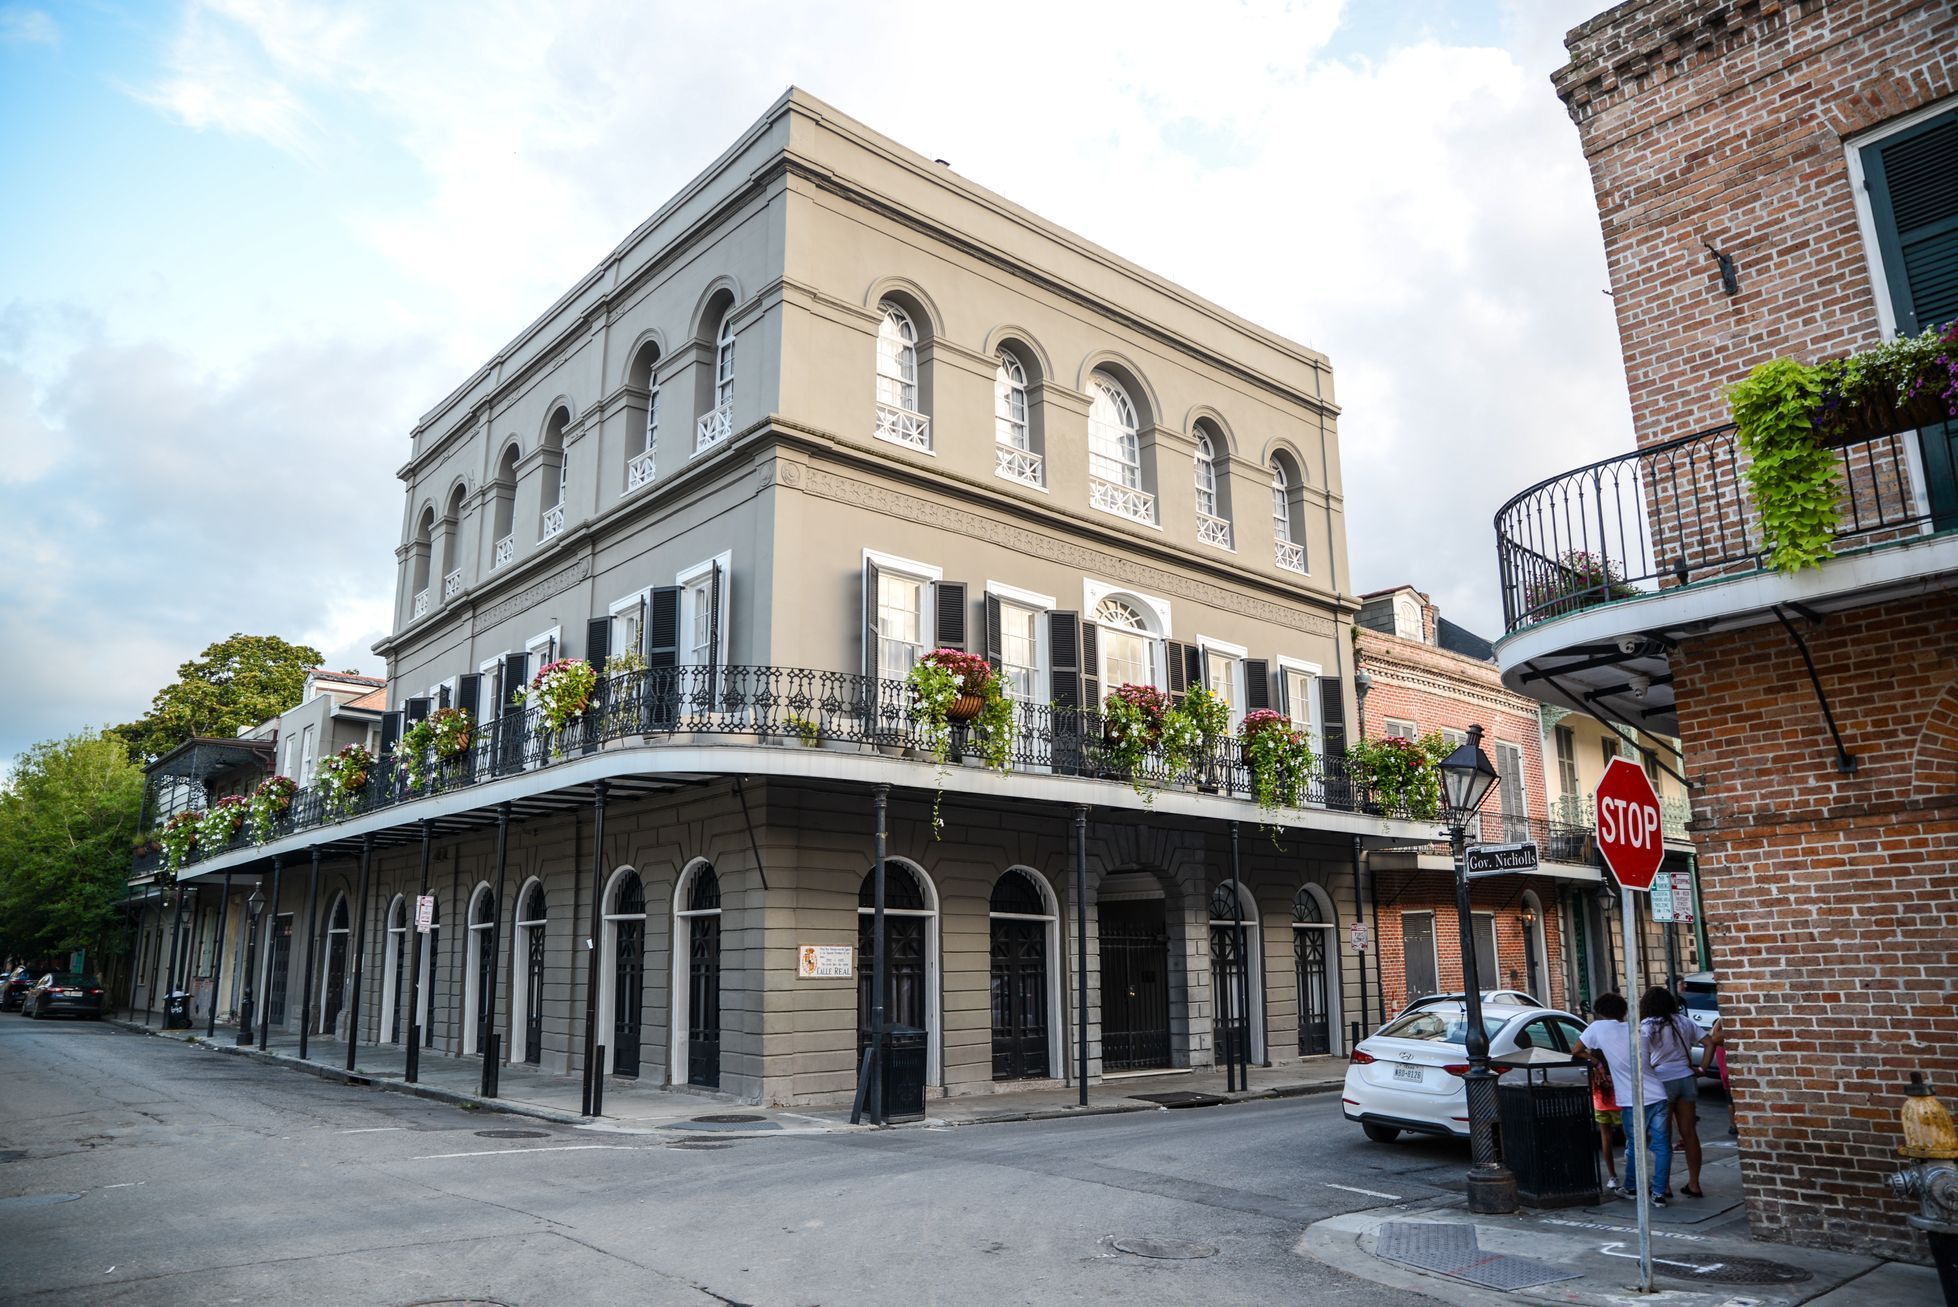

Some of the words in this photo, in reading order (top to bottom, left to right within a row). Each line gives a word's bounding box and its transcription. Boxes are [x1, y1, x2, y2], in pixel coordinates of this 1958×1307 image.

[1602, 796, 1657, 850] STOP
[1469, 855, 1492, 870] Gov.
[1495, 850, 1536, 868] Nicholls
[817, 967, 832, 975] CALLE
[834, 967, 850, 975] REAL
